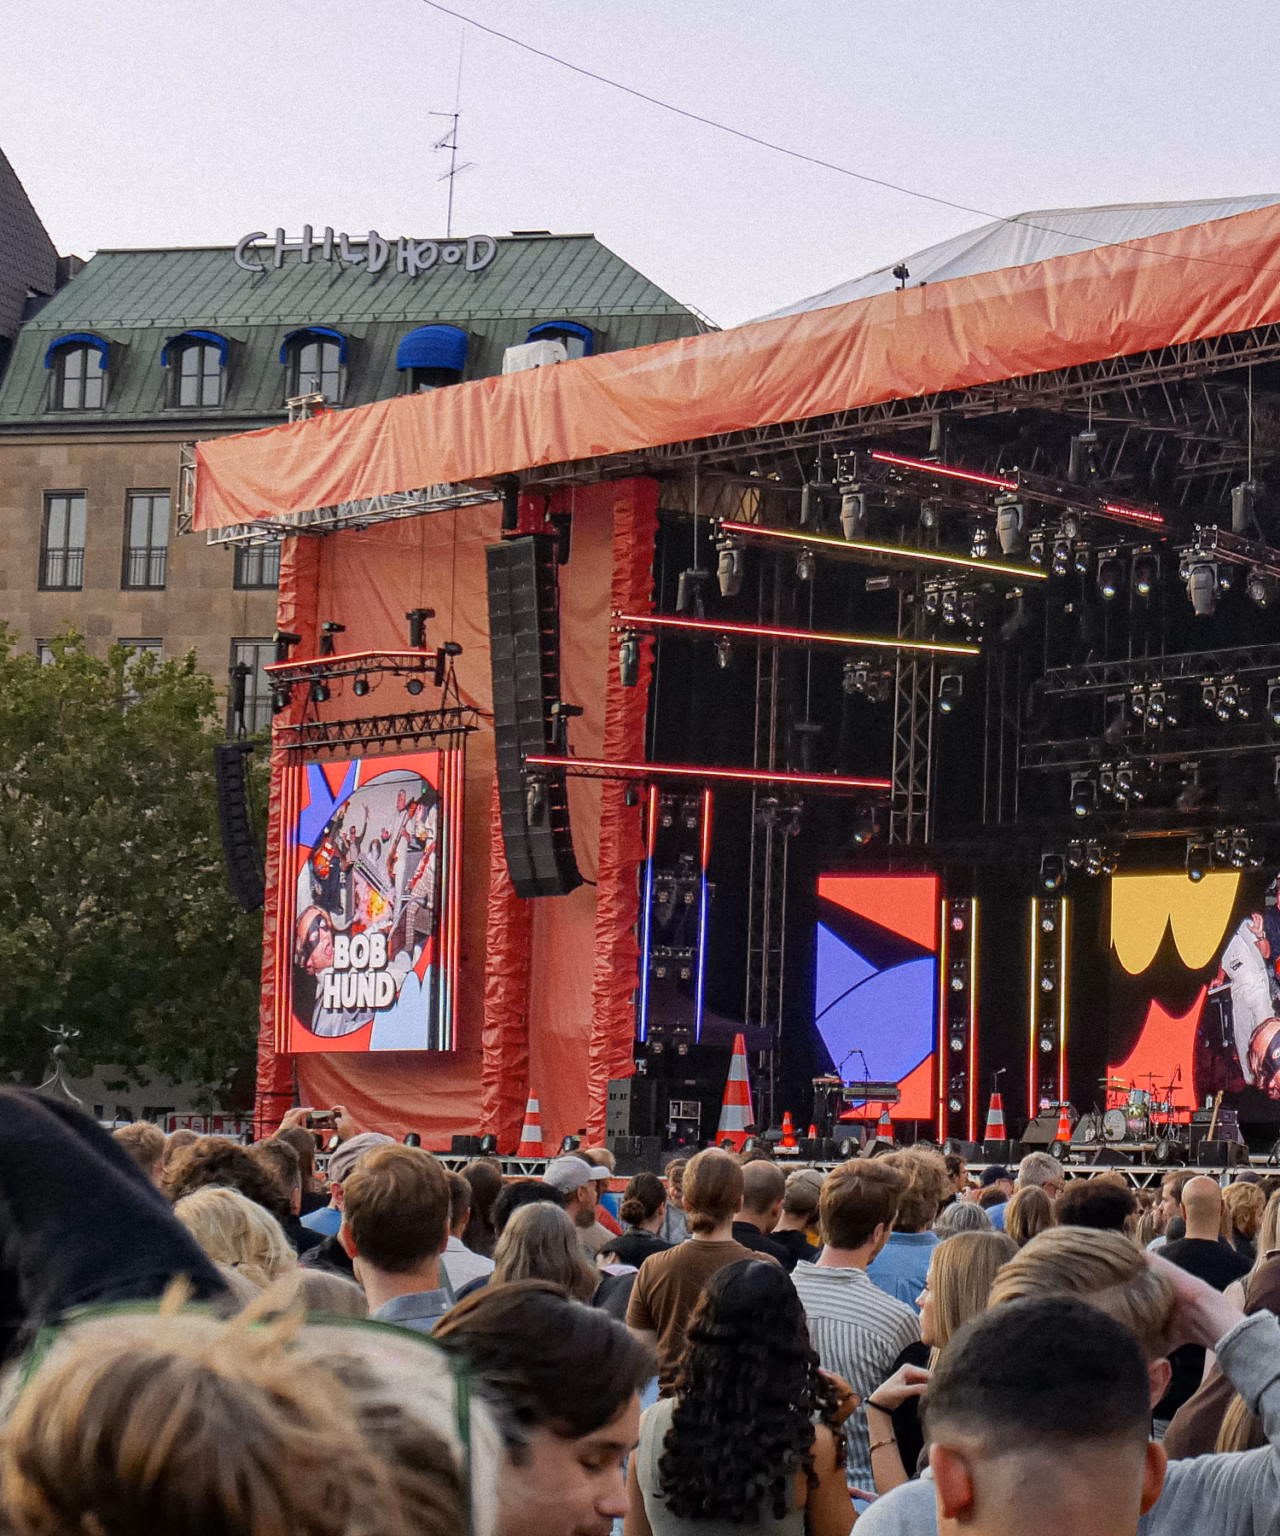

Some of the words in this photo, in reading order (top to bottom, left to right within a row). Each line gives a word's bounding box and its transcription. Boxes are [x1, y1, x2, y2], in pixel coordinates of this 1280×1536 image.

[234, 224, 497, 277] CHILDHOOD
[333, 933, 387, 969] BOB
[323, 971, 396, 1009] HUND
